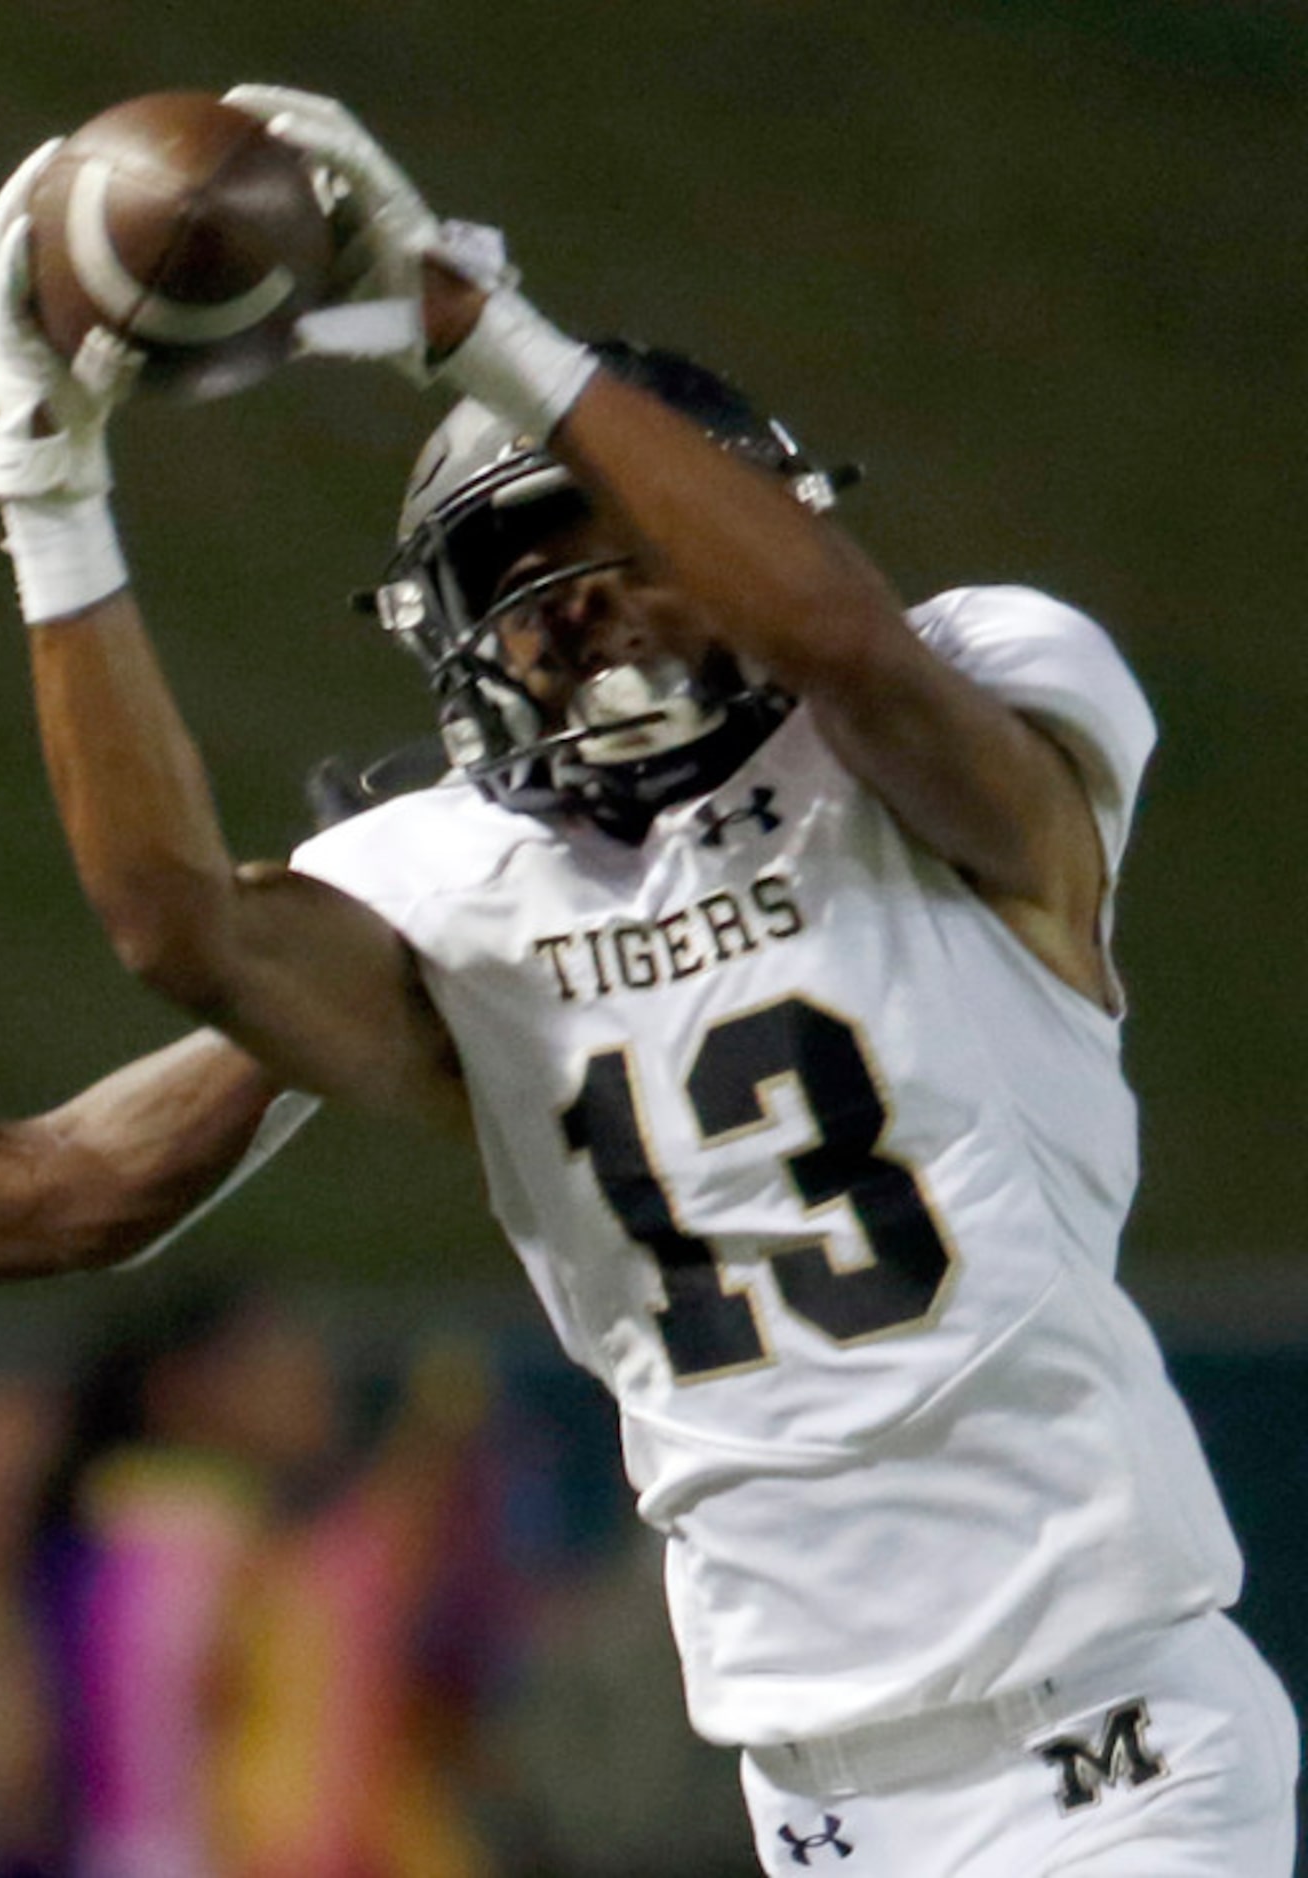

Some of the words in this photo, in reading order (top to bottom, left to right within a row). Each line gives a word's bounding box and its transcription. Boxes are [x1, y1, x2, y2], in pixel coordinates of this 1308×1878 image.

[535, 876, 804, 1001] TIGERS
[559, 992, 956, 1384] 13
[1036, 1698, 1170, 1817] M
